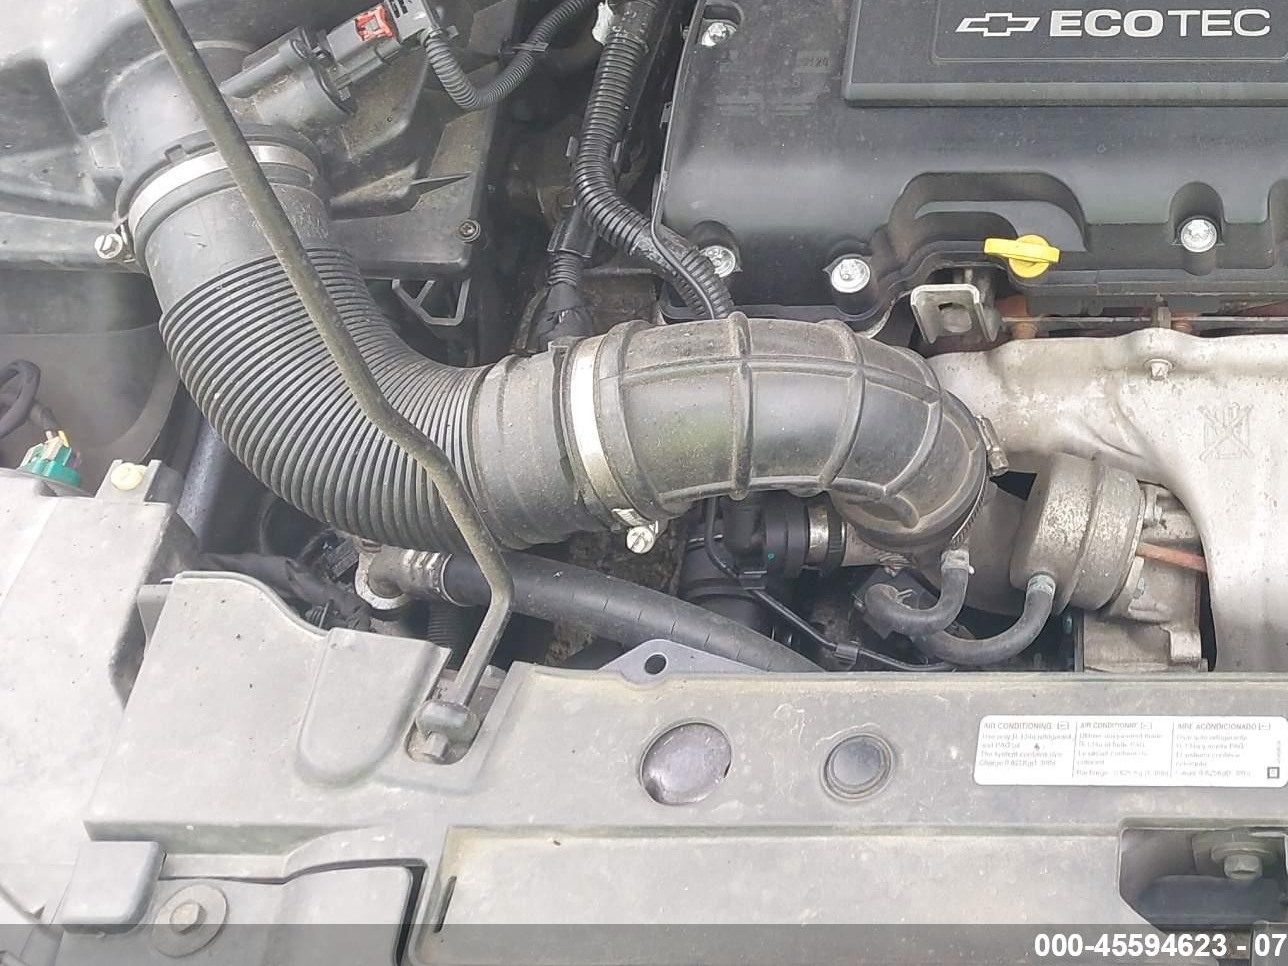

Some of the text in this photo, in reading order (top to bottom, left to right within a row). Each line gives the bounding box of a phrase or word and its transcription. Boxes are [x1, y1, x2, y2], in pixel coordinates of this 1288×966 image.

[1050, 9, 1271, 37] ECOTEC
[984, 722, 1052, 730] AIR CONDITIONING
